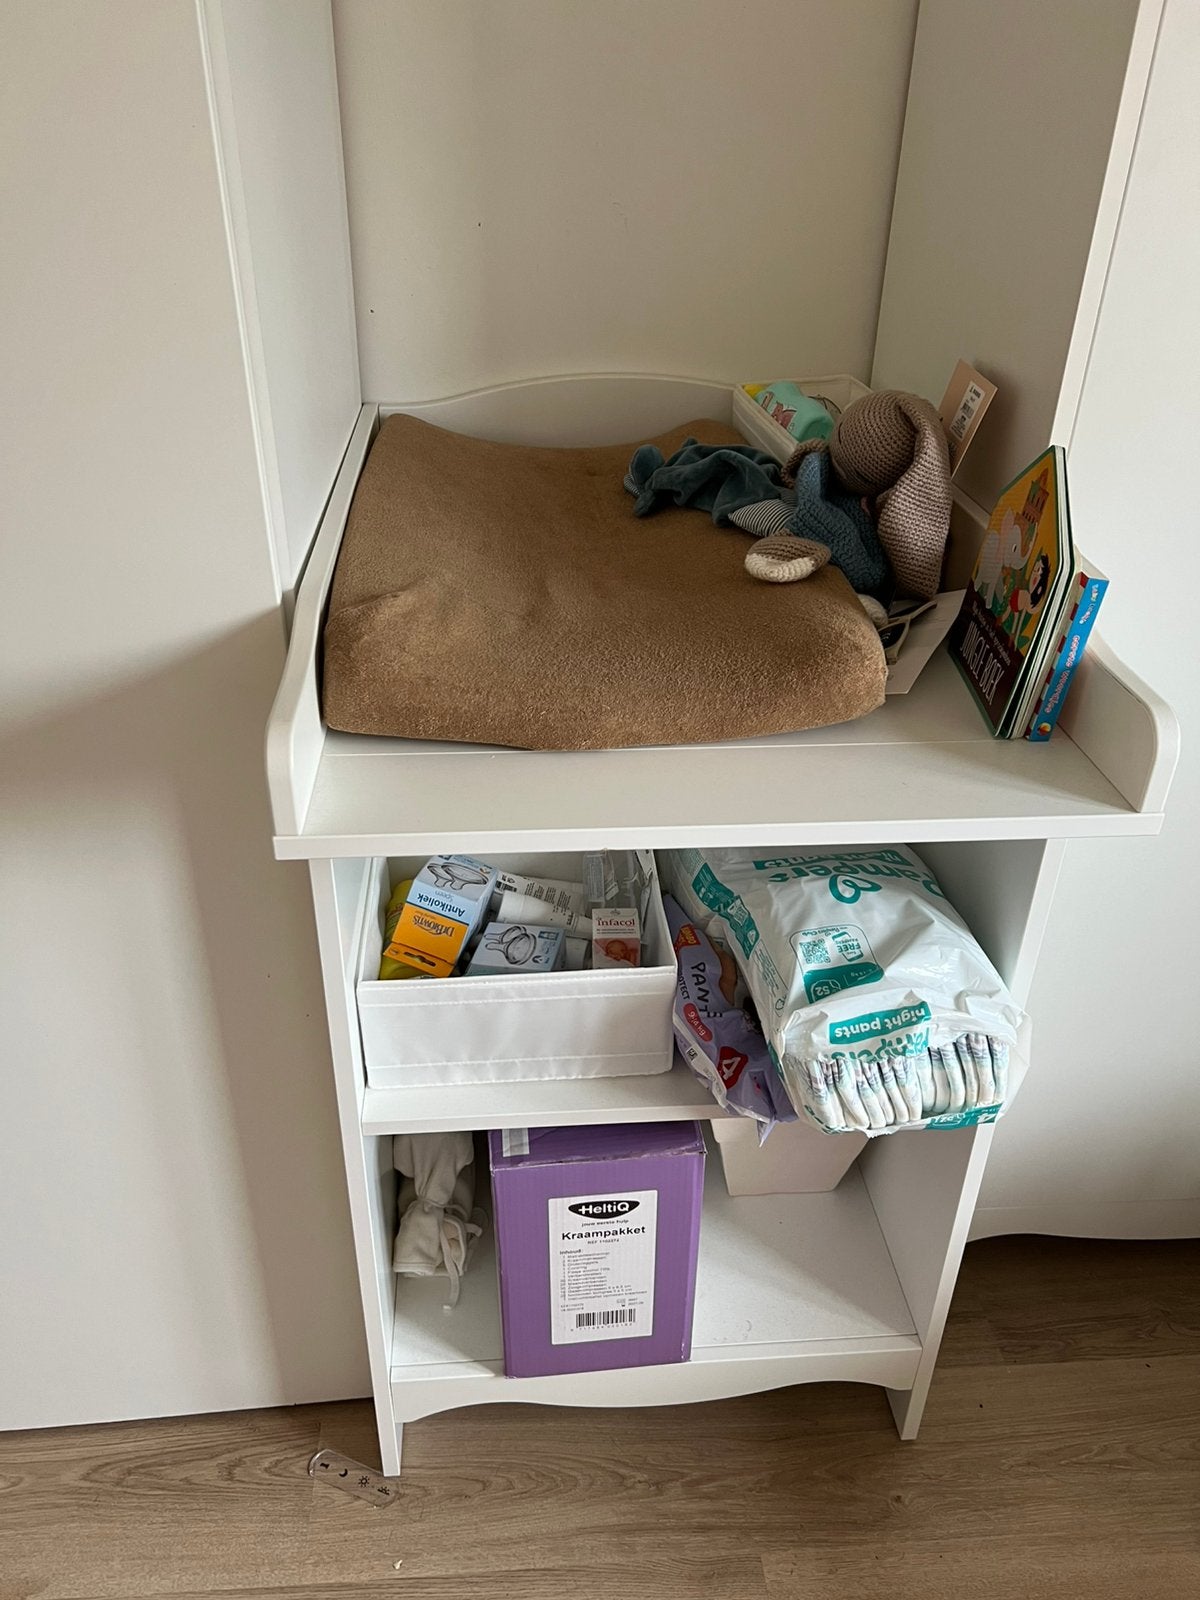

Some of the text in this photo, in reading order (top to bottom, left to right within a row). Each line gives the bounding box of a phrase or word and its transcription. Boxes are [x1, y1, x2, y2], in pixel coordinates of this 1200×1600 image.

[960, 620, 990, 680] JUNGLE
[980, 652, 1006, 707] BOEK
[416, 892, 466, 918] Antikoliek
[836, 943, 861, 953] FREE
[814, 985, 831, 996] 52
[834, 1007, 926, 1039] night pants
[720, 1057, 743, 1080] 4
[578, 1201, 630, 1215] HeltiQ
[561, 1226, 646, 1241] Kraampakket
